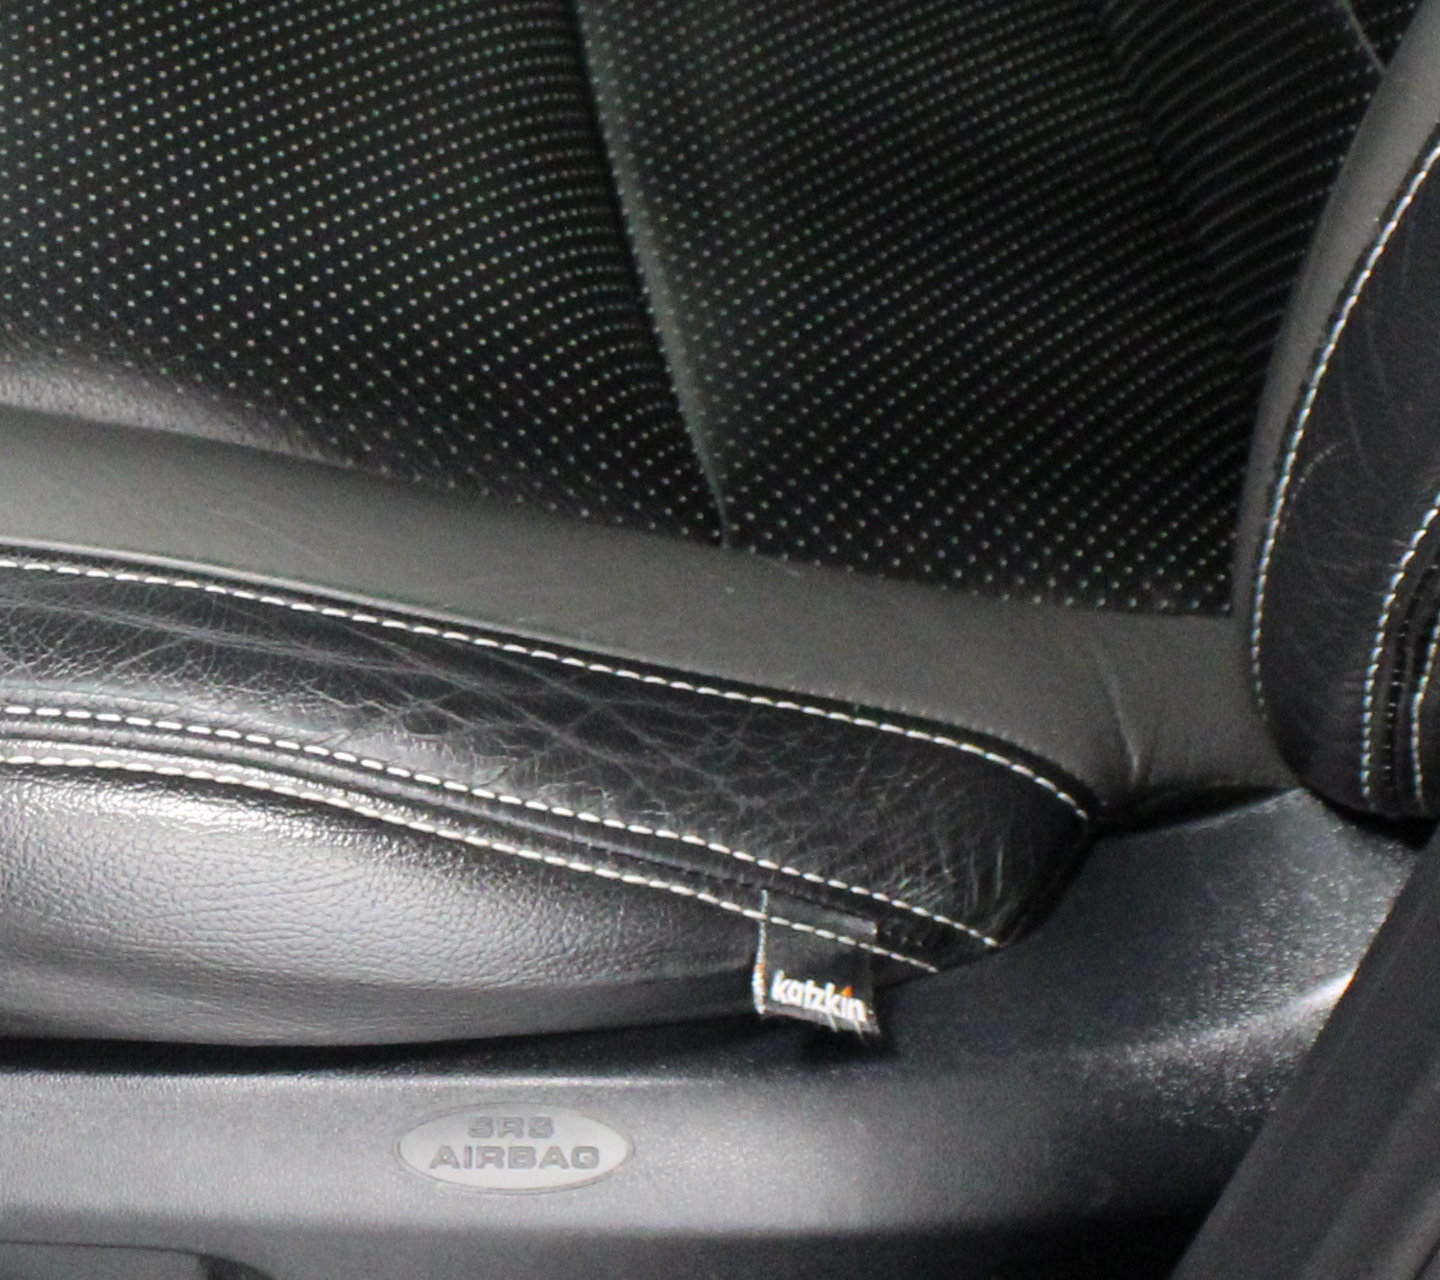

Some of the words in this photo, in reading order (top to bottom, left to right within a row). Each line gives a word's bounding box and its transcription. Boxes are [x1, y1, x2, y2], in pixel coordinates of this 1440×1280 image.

[772, 969, 870, 1022] katzkin
[467, 1116, 555, 1139] SRS
[429, 1145, 601, 1170] AIRBAG
